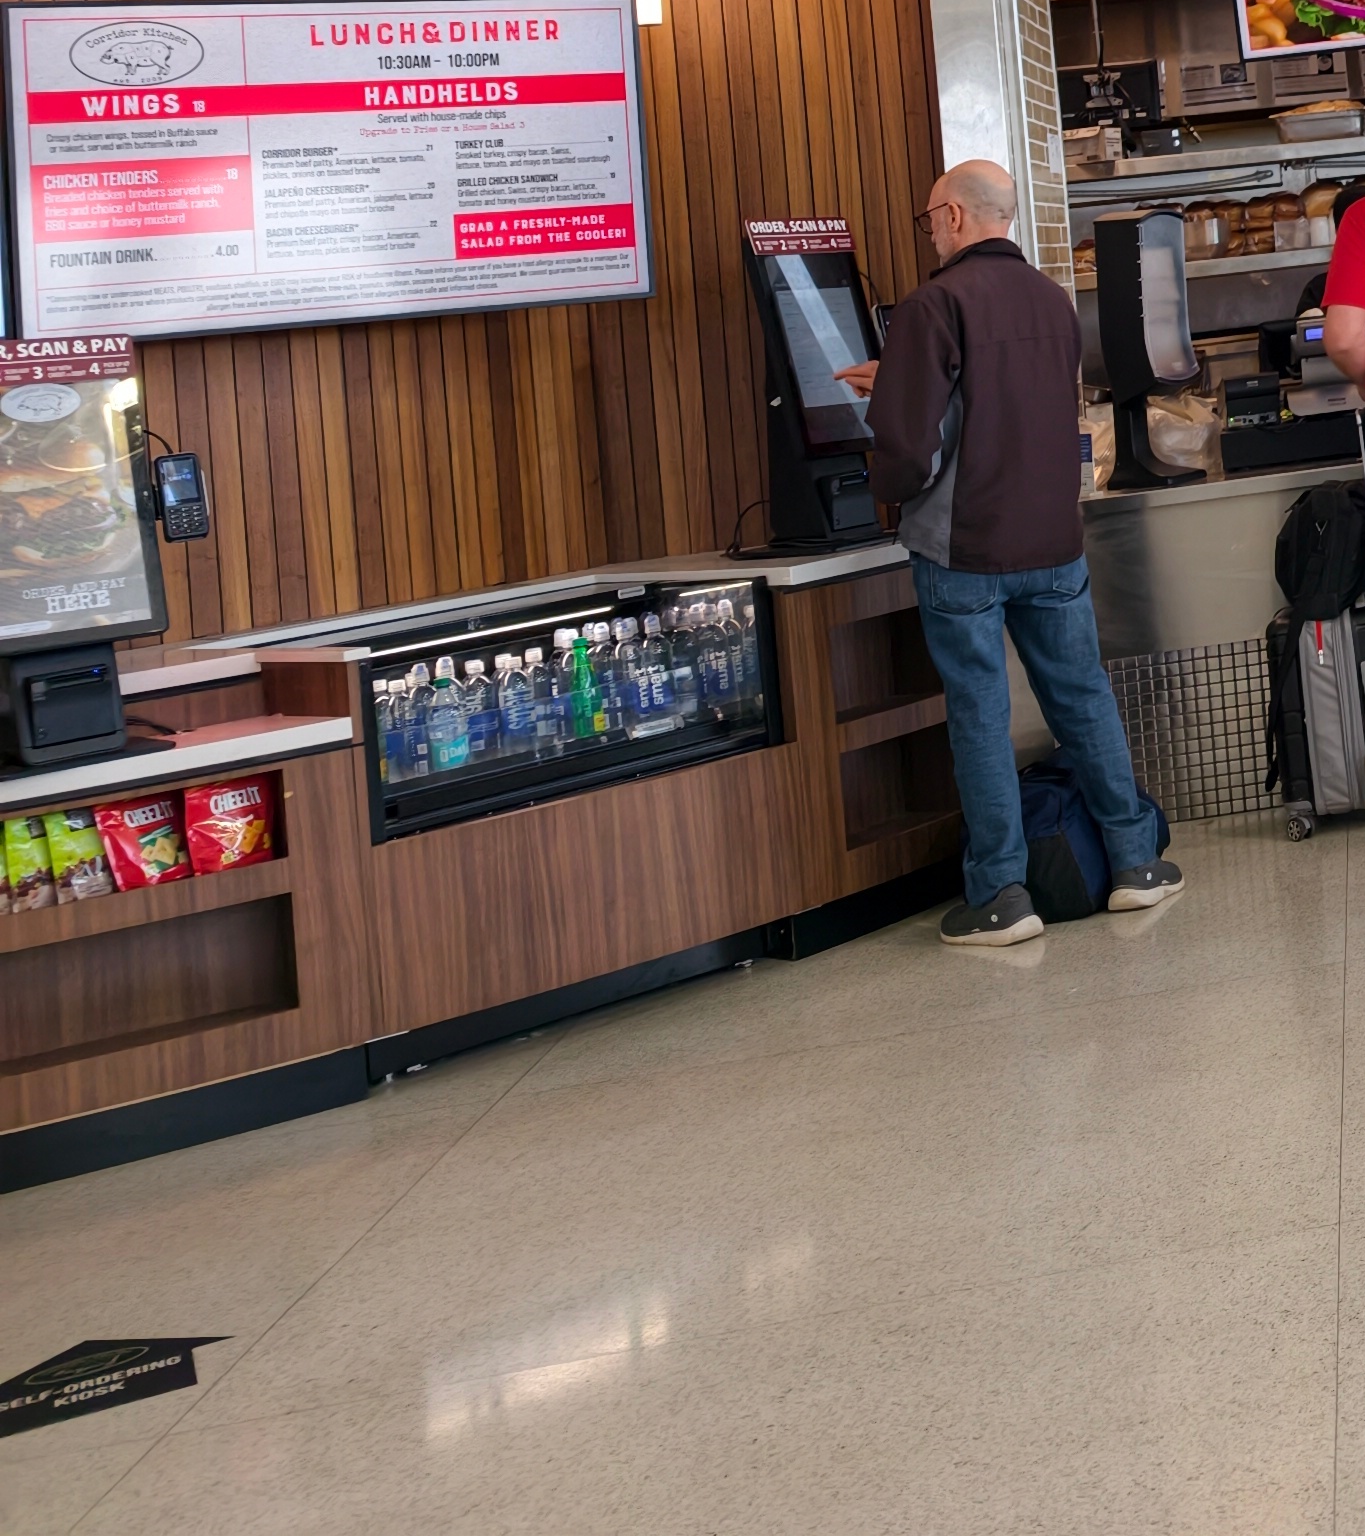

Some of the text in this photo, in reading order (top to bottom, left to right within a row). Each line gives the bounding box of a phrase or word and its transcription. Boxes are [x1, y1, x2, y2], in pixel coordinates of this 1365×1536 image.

[85, 28, 188, 49] Corridor Kitchen
[377, 53, 500, 70] 10:30AM 10:00PM
[364, 82, 518, 106] HANDHELDS
[81, 94, 206, 116] WINGS 18
[377, 109, 507, 124] Served with house-made chips
[262, 149, 302, 159] CORRIDOR
[455, 140, 483, 150] TURKEY
[485, 139, 504, 148] CLUB
[43, 168, 238, 190] CHICKEN TENDERS 18
[457, 177, 487, 187] GRILLED
[489, 176, 518, 186] CHICKEN
[521, 174, 558, 184] SANDWICH
[44, 184, 224, 203] Breaded chicken tenders served with
[497, 197, 516, 206] honey
[518, 195, 546, 204] mustard
[556, 193, 581, 201] toasted
[45, 206, 69, 217] fries
[70, 205, 89, 216] and
[91, 203, 123, 215] choice
[125, 202, 136, 213] of
[138, 200, 188, 212] buttermilk
[68, 219, 97, 230] sauce
[99, 218, 110, 228] or
[112, 216, 142, 228] honey
[144, 213, 185, 225] mustard
[460, 214, 606, 233] GRAB A FRESHLY-MADE
[749, 219, 847, 233] ORDER, SCAN & PAY
[266, 228, 293, 238] BACON
[461, 228, 626, 249] SALAD FROM THE COOLER!
[755, 238, 837, 251] 1 2 3 4
[50, 250, 112, 268] FOUNTAIN
[216, 245, 239, 257] 4.00
[16, 341, 69, 357] SCAN
[72, 340, 88, 354] &
[90, 337, 129, 353] PAY
[32, 366, 44, 380] 3
[89, 362, 100, 375] 4
[22, 577, 126, 600] ORDER AND PAY
[45, 590, 111, 614] HERE
[634, 667, 650, 708] smart
[649, 664, 665, 705] smart
[0, 1354, 182, 1412] SELF-ORDERING
[53, 1380, 126, 1408] KIOSK
